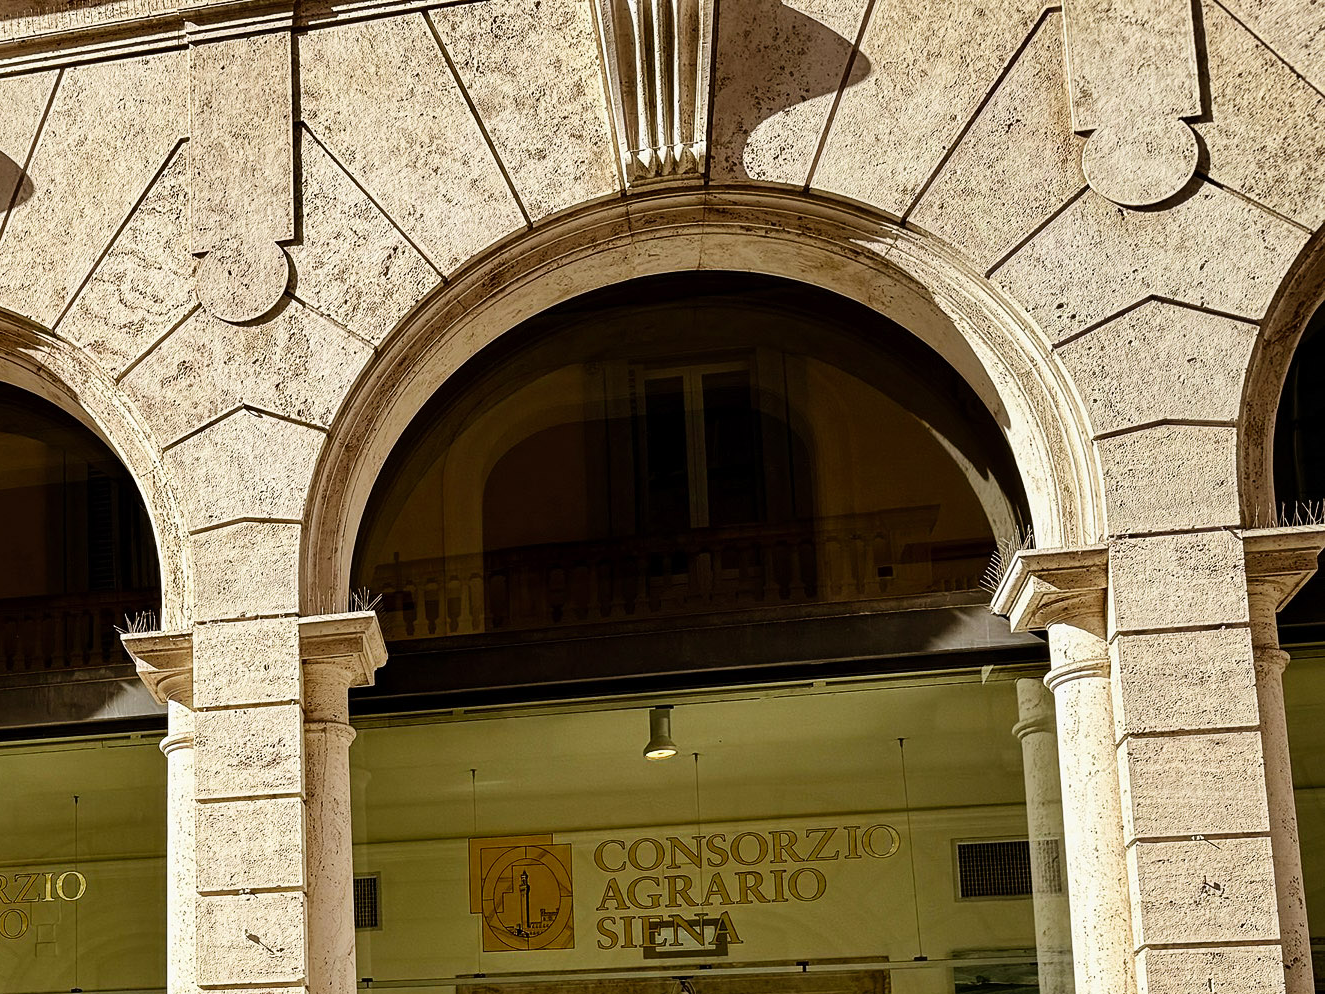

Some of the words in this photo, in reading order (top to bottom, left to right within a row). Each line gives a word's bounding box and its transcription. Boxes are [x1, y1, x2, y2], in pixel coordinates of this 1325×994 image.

[593, 824, 902, 874] CONSORZIO
[594, 866, 828, 912] AGRARIO
[595, 910, 743, 950] SIENA
